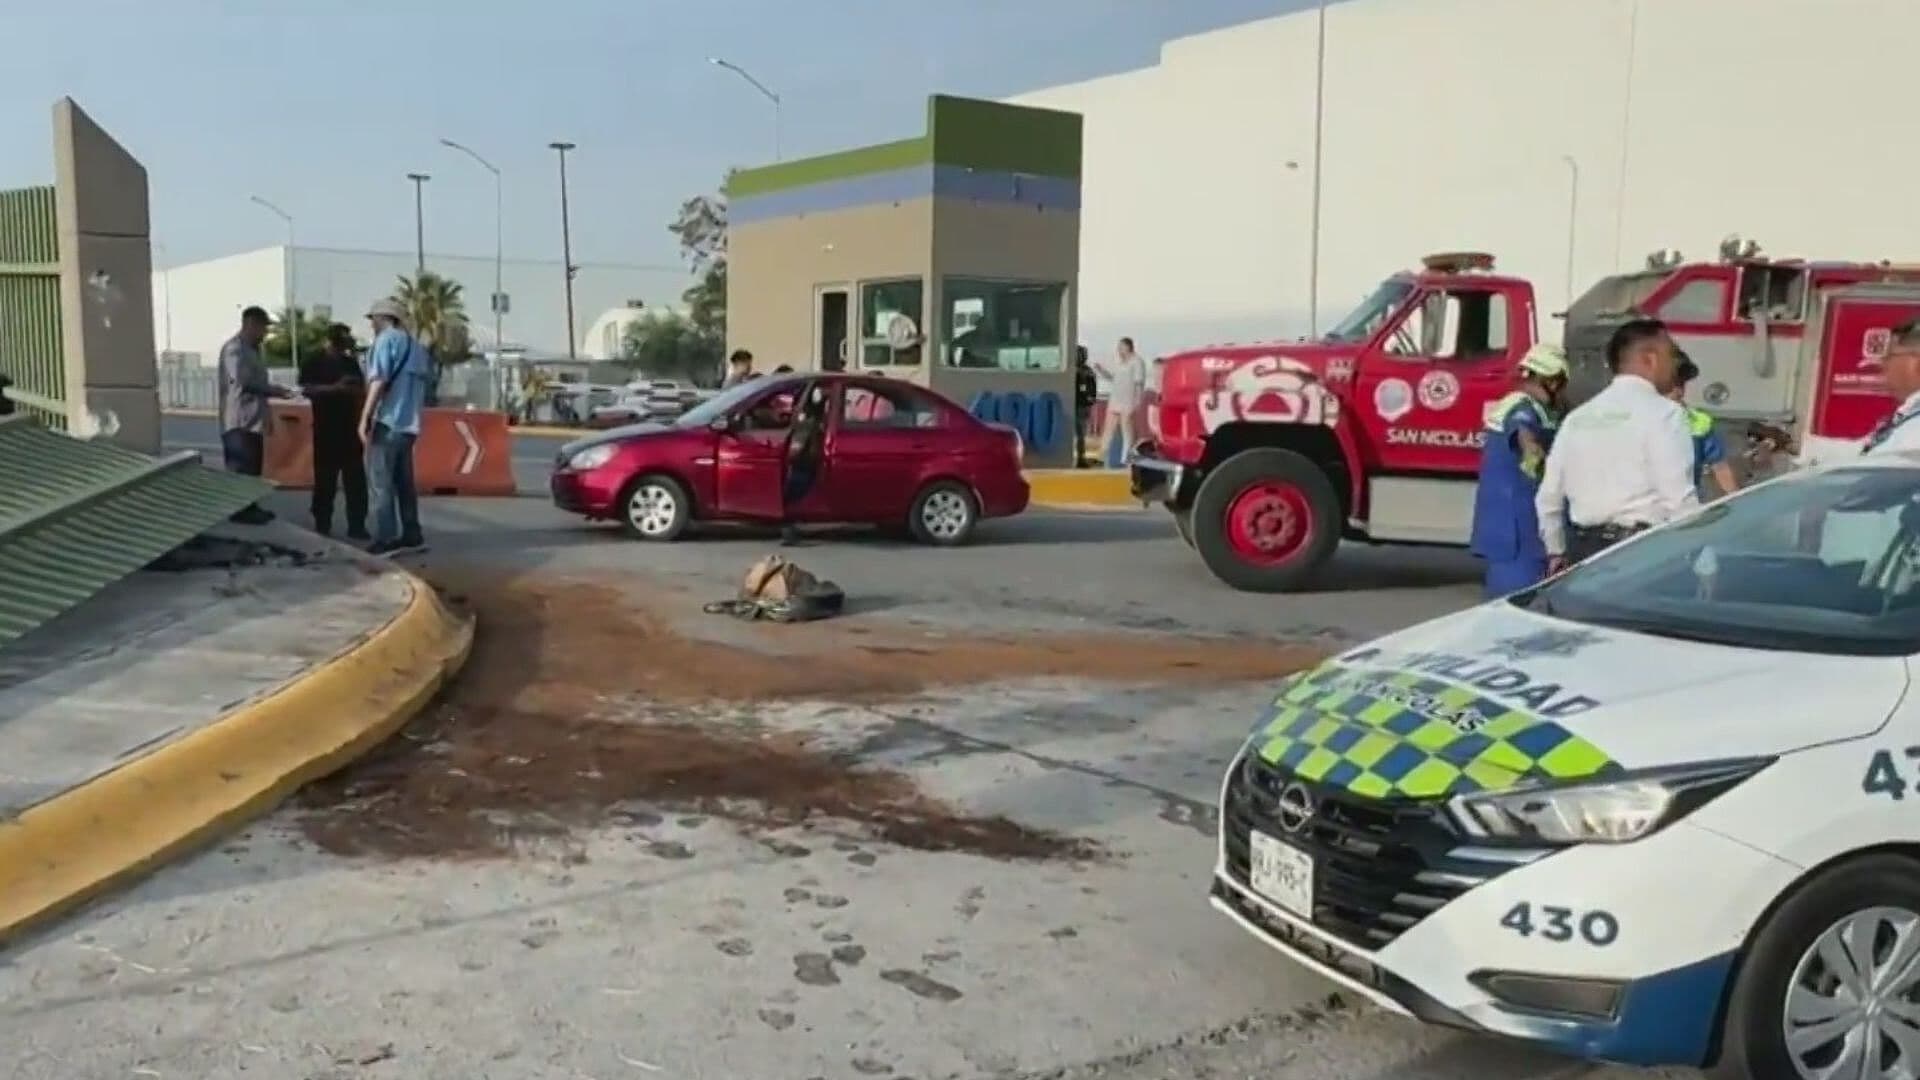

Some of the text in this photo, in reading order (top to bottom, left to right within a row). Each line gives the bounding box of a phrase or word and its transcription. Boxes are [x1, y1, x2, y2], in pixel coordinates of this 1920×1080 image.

[1386, 428, 1486, 448] SAN NICOLAS
[1500, 901, 1619, 946] 430
